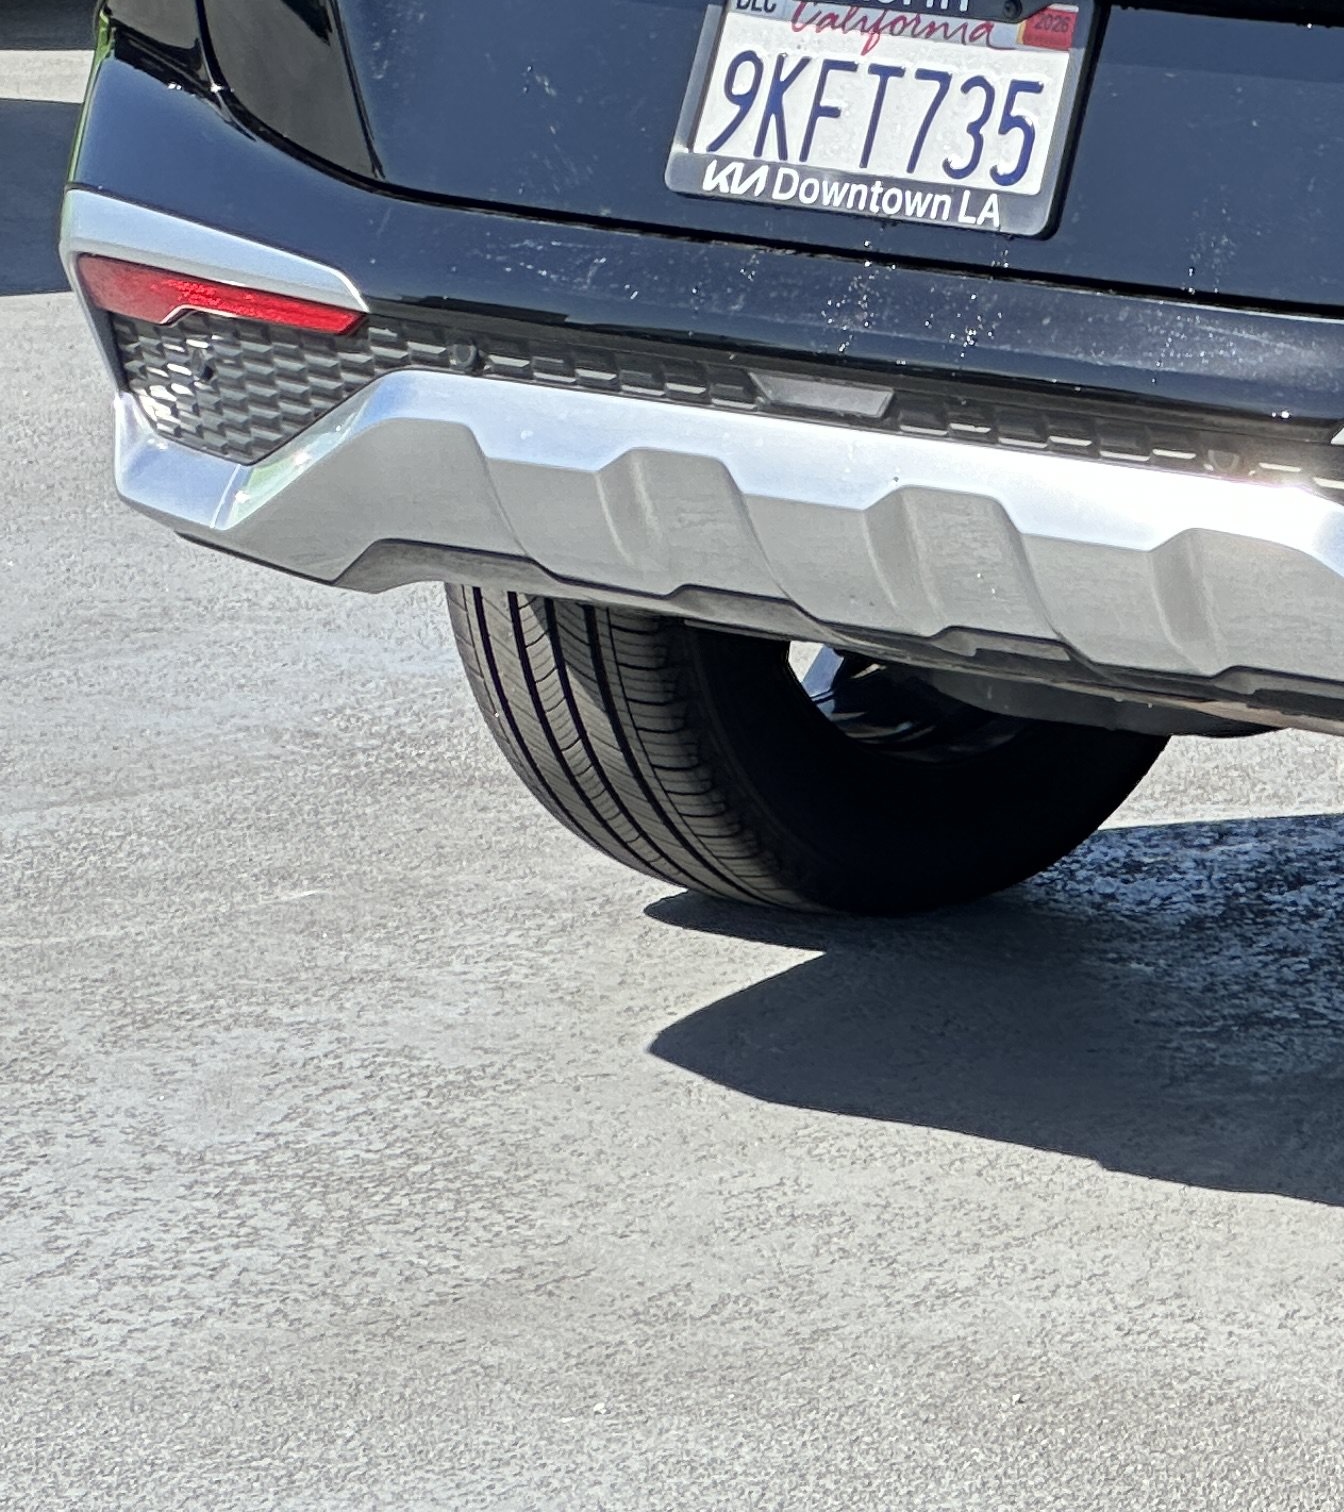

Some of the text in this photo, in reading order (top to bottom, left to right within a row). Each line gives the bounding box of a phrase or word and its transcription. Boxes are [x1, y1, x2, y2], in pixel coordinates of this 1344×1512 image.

[791, 1, 1017, 56] California
[1034, 13, 1072, 33] 2026
[706, 49, 1045, 188] 9KFT735
[702, 159, 1001, 228] KIA Downtown LA
